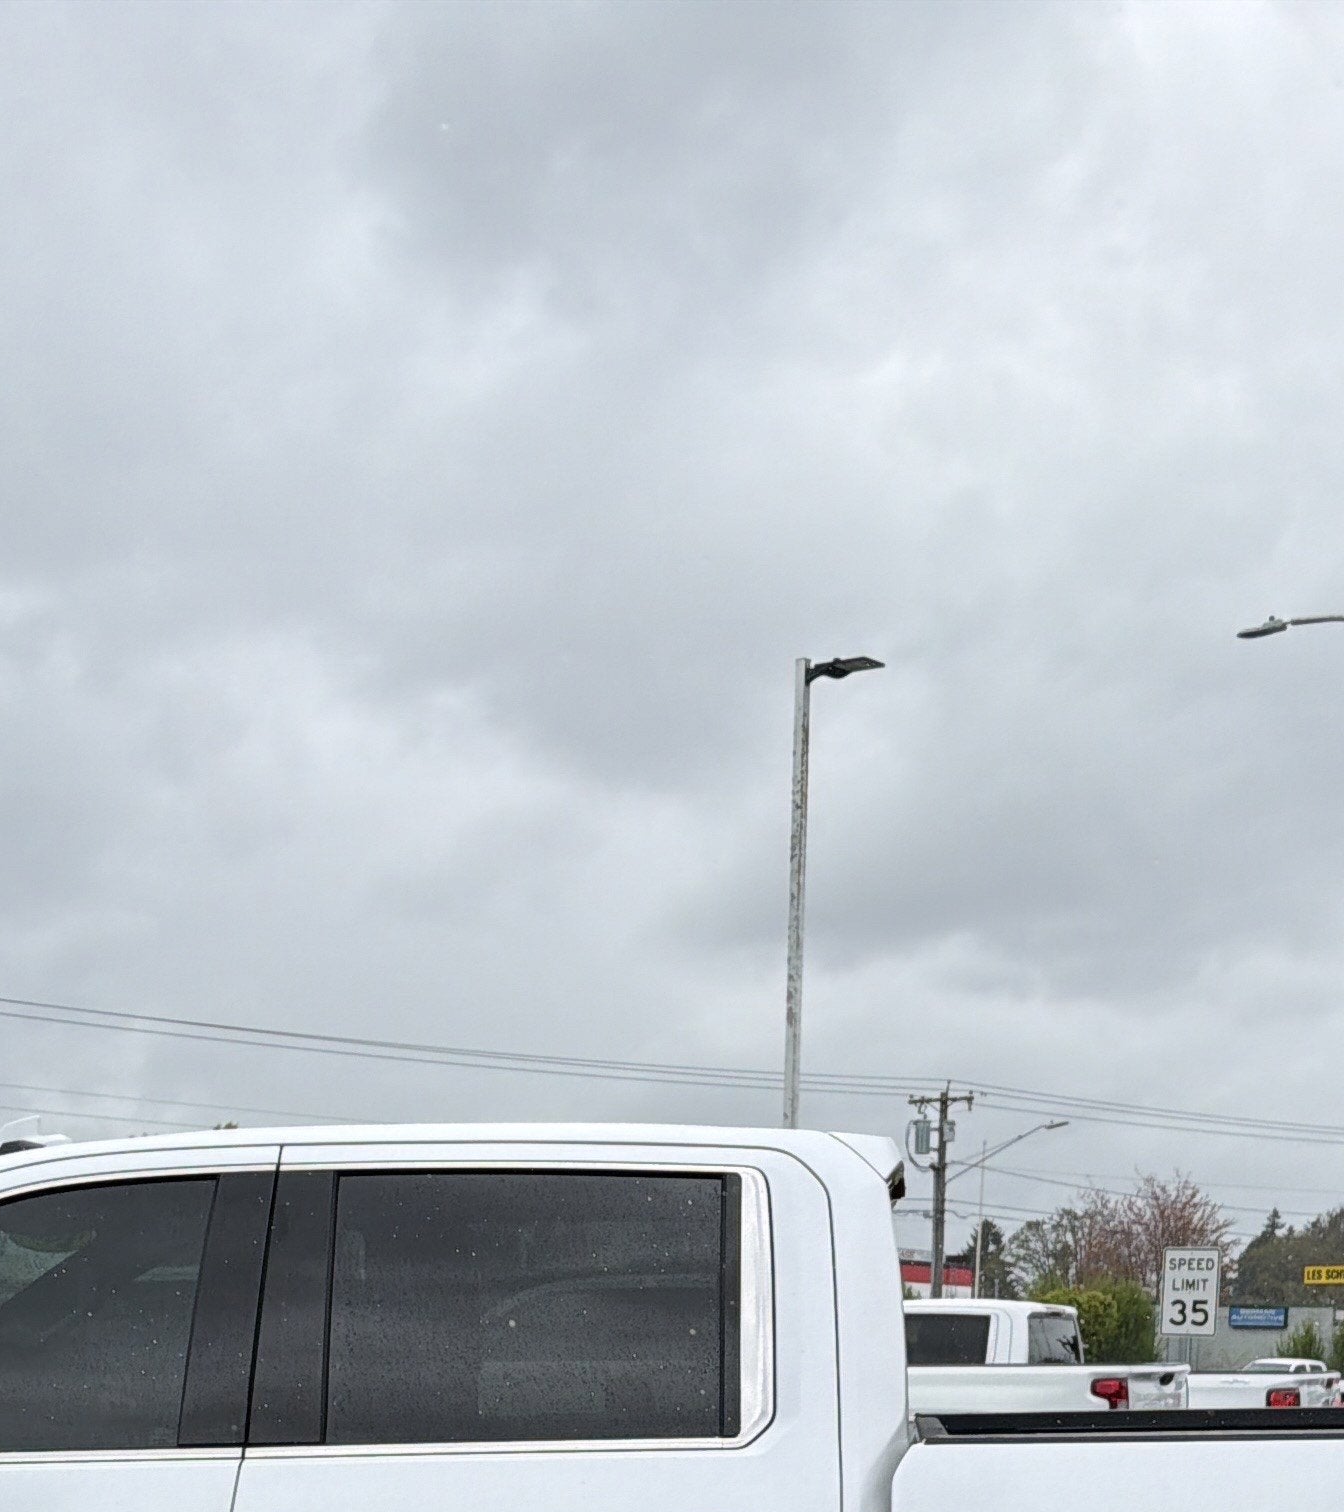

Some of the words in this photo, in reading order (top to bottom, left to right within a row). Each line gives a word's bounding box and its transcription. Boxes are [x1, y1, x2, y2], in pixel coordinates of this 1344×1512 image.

[1169, 1258, 1215, 1271] SPEED
[1306, 1269, 1323, 1280] LES
[1172, 1278, 1208, 1291] LIMIT
[1169, 1300, 1209, 1326] 35
